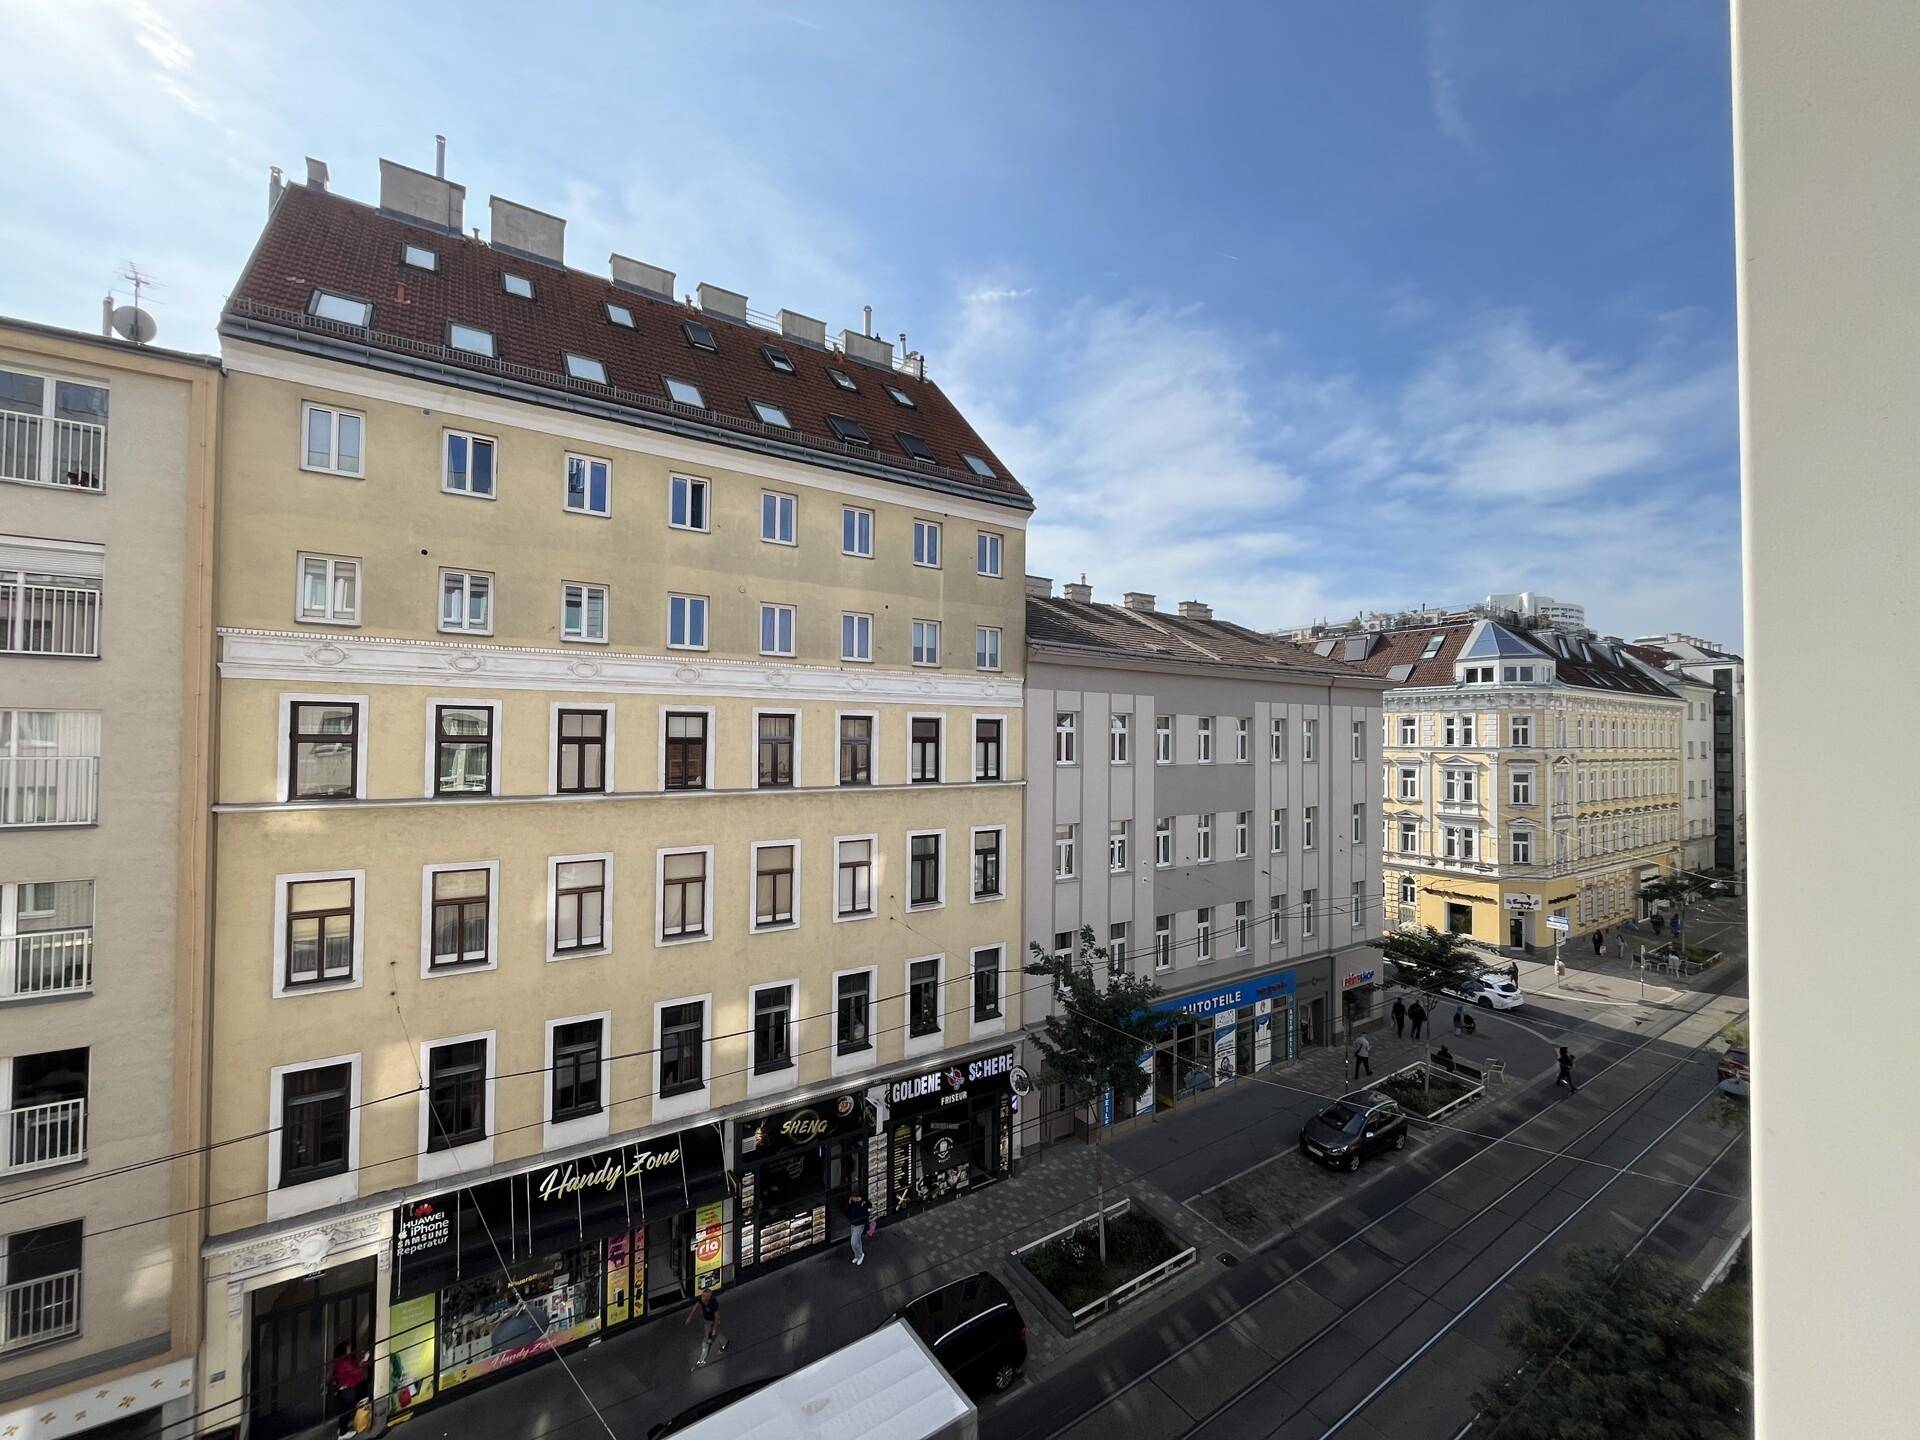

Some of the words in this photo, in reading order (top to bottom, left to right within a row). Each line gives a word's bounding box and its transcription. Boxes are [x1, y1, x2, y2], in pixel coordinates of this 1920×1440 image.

[1182, 990, 1242, 1015] AUTOTEILE
[892, 1072, 942, 1103] GOLDENE
[968, 1053, 1014, 1081] SCHERE
[940, 1091, 968, 1106] FRISEUR
[780, 1120, 828, 1135] SHENG
[538, 1157, 622, 1201] Handy
[624, 1149, 680, 1178] Zone
[403, 1211, 445, 1229] HUAWEI
[410, 1219, 450, 1237] iPhone
[396, 1236, 449, 1256] Reperatur
[397, 1227, 449, 1249] SAMSUNG
